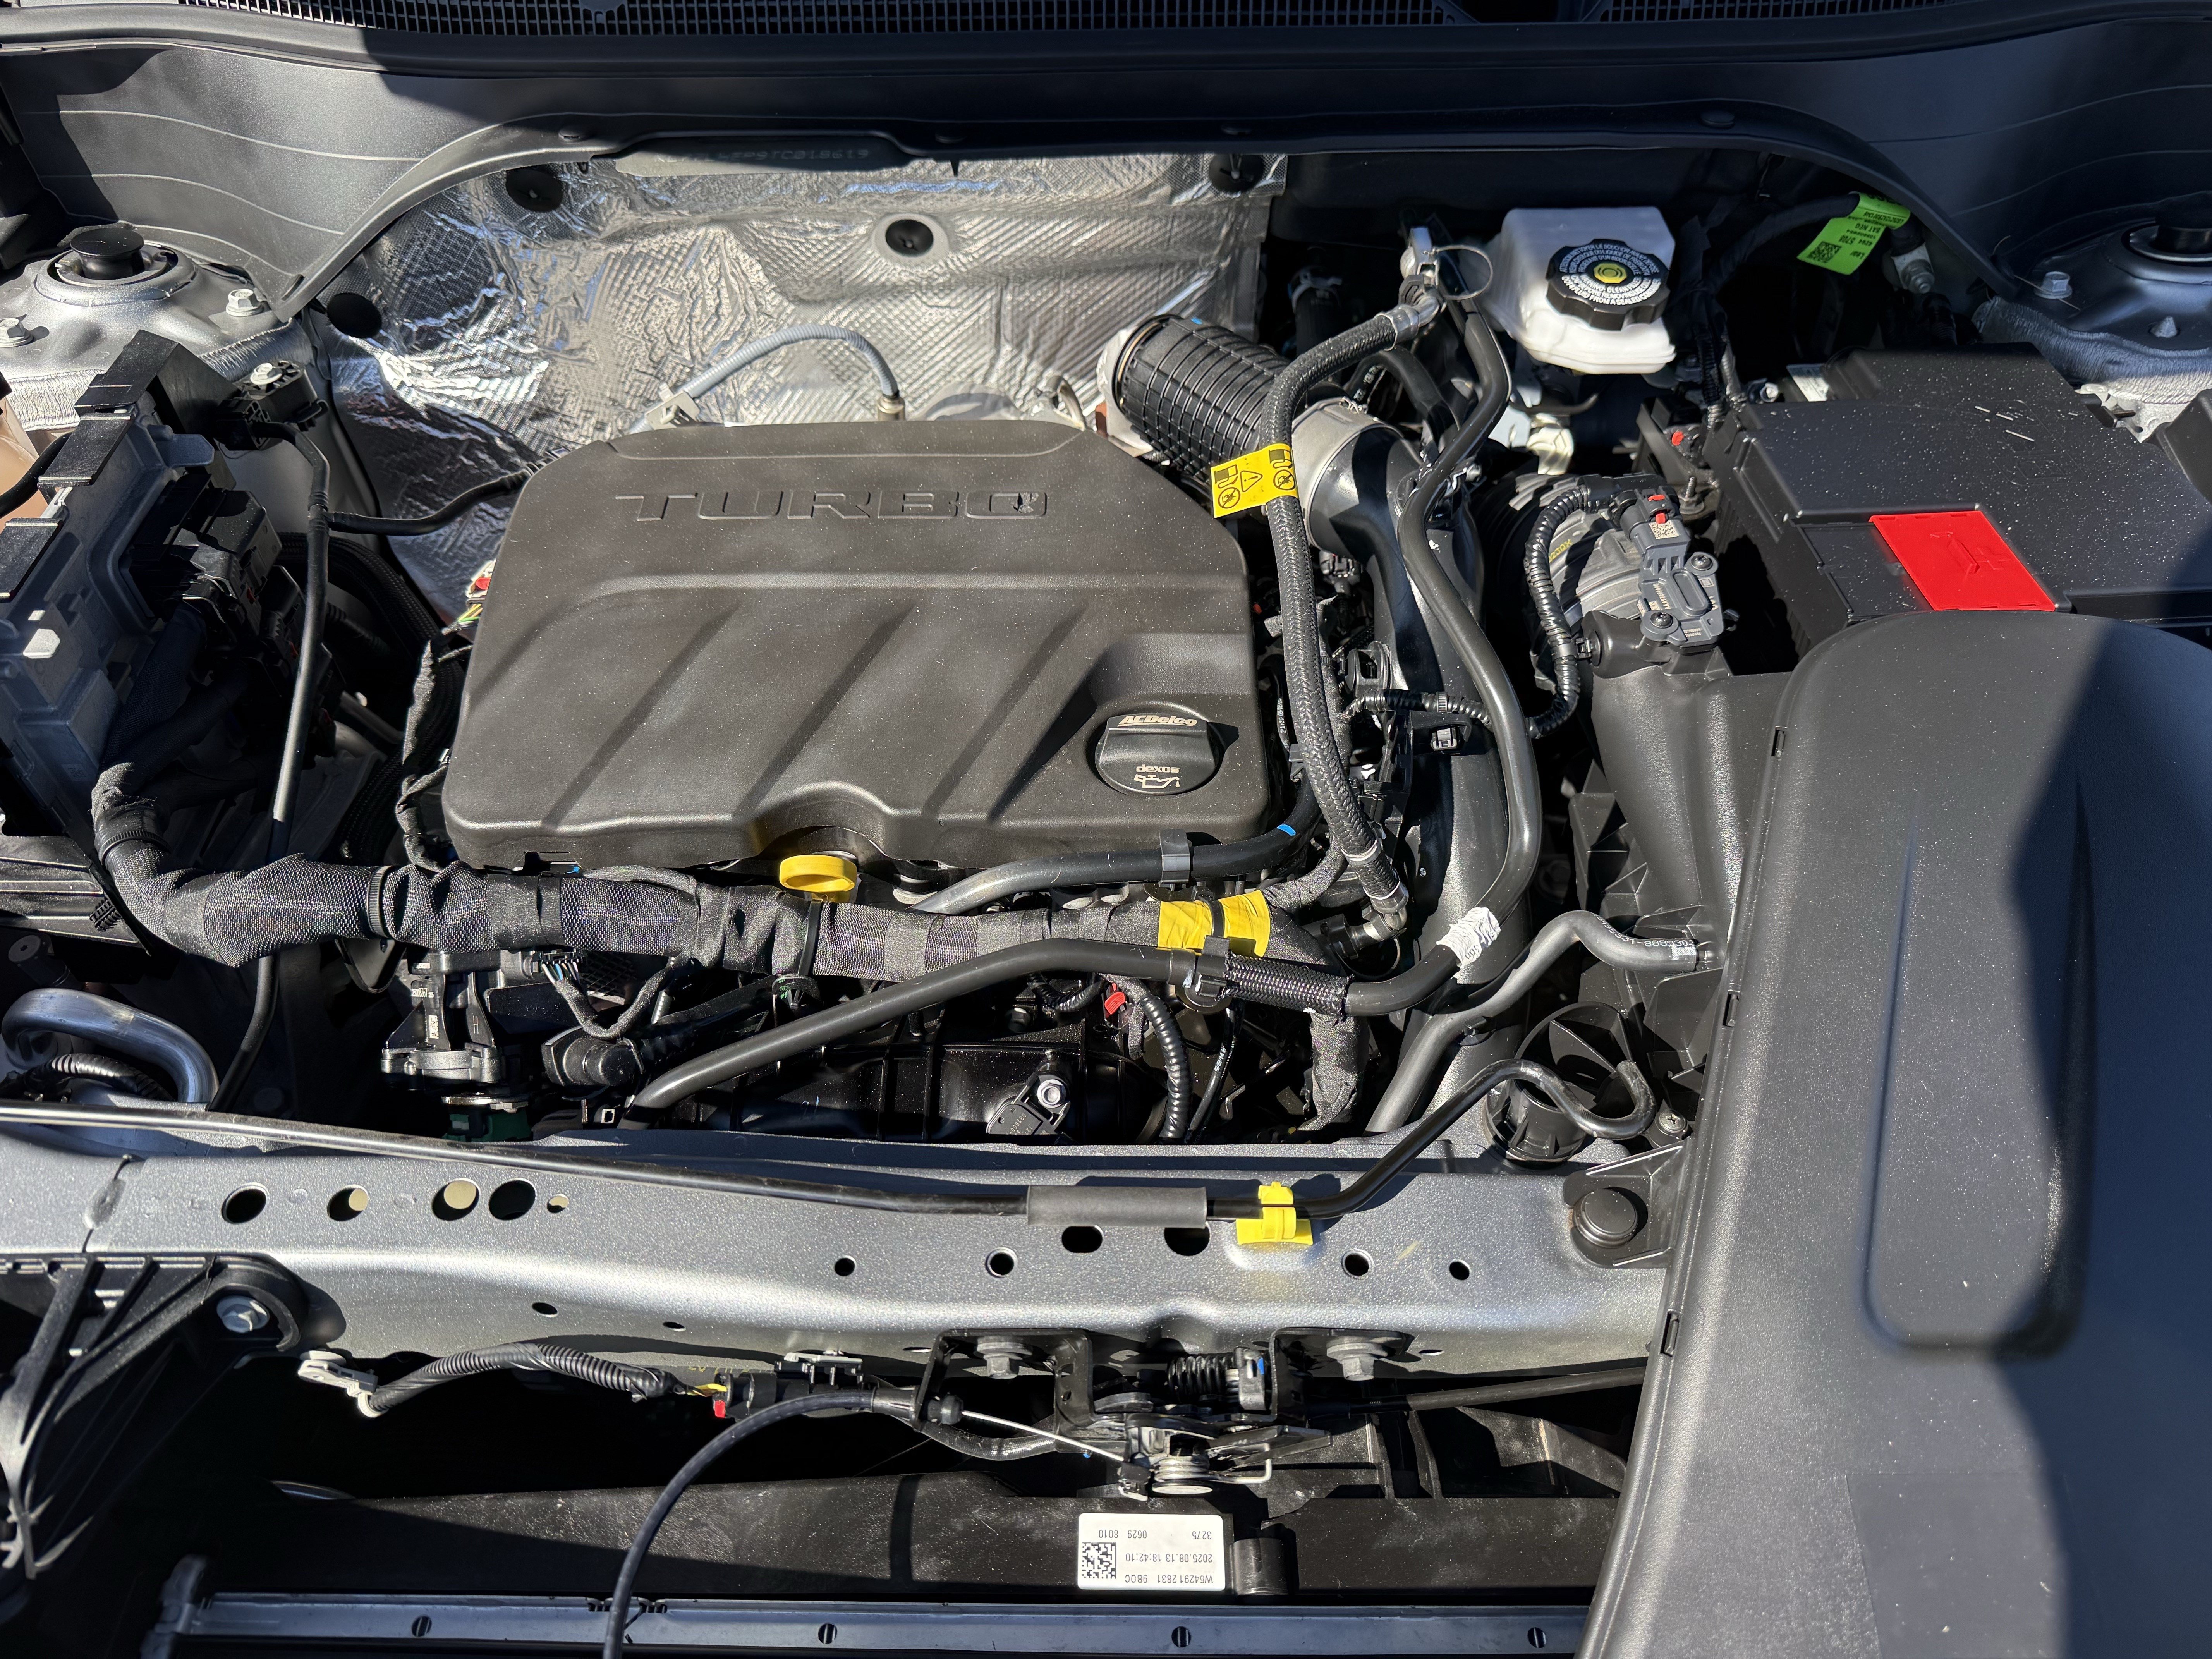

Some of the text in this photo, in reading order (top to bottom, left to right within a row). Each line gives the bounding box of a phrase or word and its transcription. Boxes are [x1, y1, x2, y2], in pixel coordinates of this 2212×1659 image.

[1607, 285, 1630, 293] CLEAN
[1589, 294, 1610, 304] FROM
[615, 490, 1048, 522] TURBO
[1118, 715, 1198, 726] ACDelco
[1136, 764, 1181, 773] dexos
[1098, 1530, 1212, 1540] 3275 0629 8010
[1125, 1553, 1213, 1563] 2025.08.13 18:42:10
[1125, 1575, 1148, 1583] 9BQC
